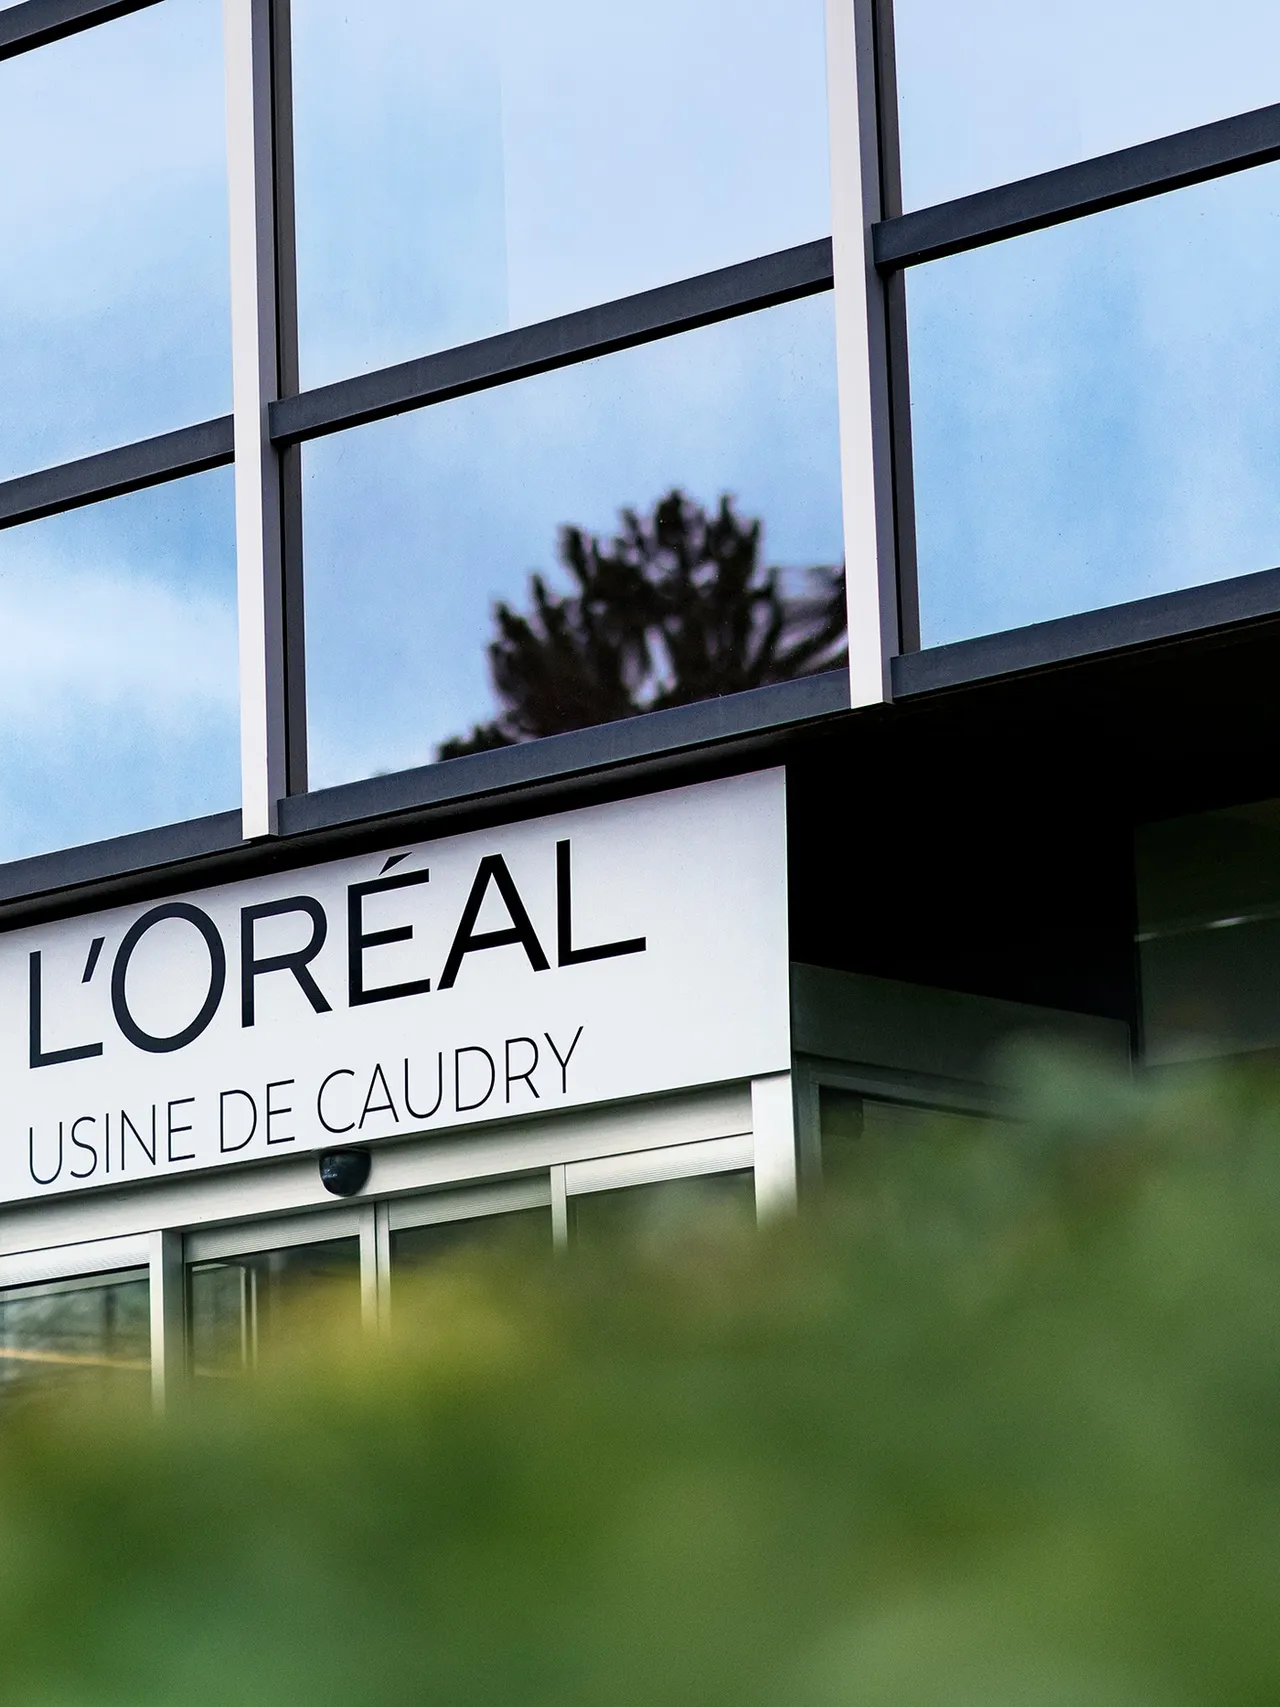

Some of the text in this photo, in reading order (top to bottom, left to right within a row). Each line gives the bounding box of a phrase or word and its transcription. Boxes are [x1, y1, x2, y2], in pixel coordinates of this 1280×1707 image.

[29, 838, 647, 1069] L'ORÉAL
[29, 1025, 584, 1185] USINE DE CAUDRY
